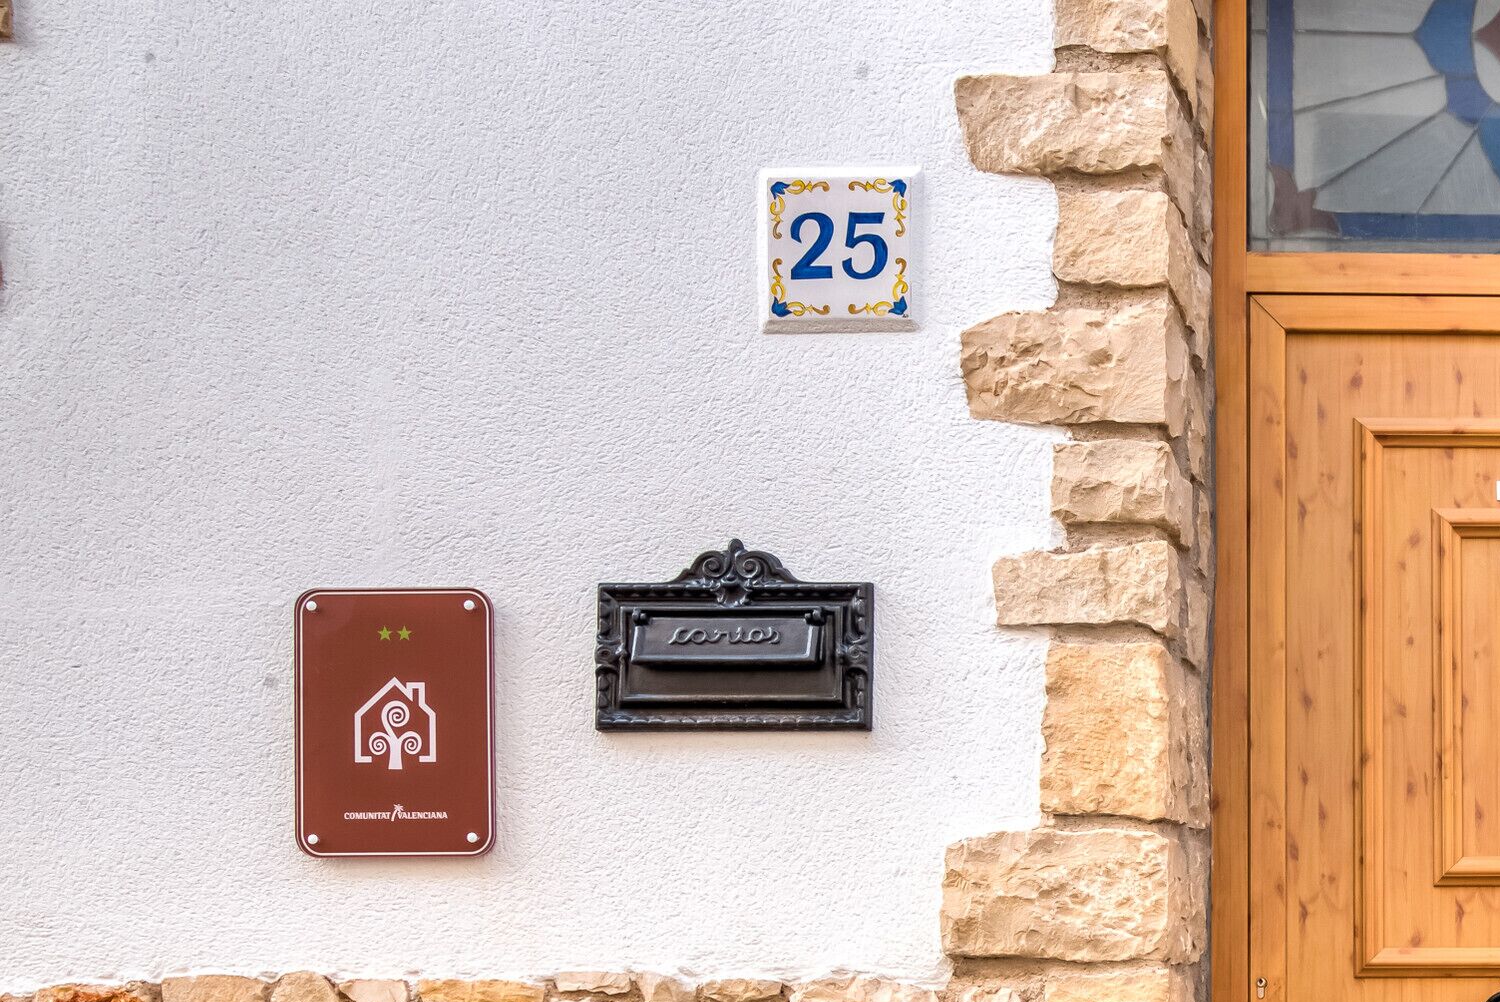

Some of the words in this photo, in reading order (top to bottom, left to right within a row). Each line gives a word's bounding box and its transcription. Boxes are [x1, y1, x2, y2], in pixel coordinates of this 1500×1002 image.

[790, 211, 888, 280] 25
[344, 811, 391, 820] COMUNITAT
[397, 811, 448, 820] VALENCIANA
